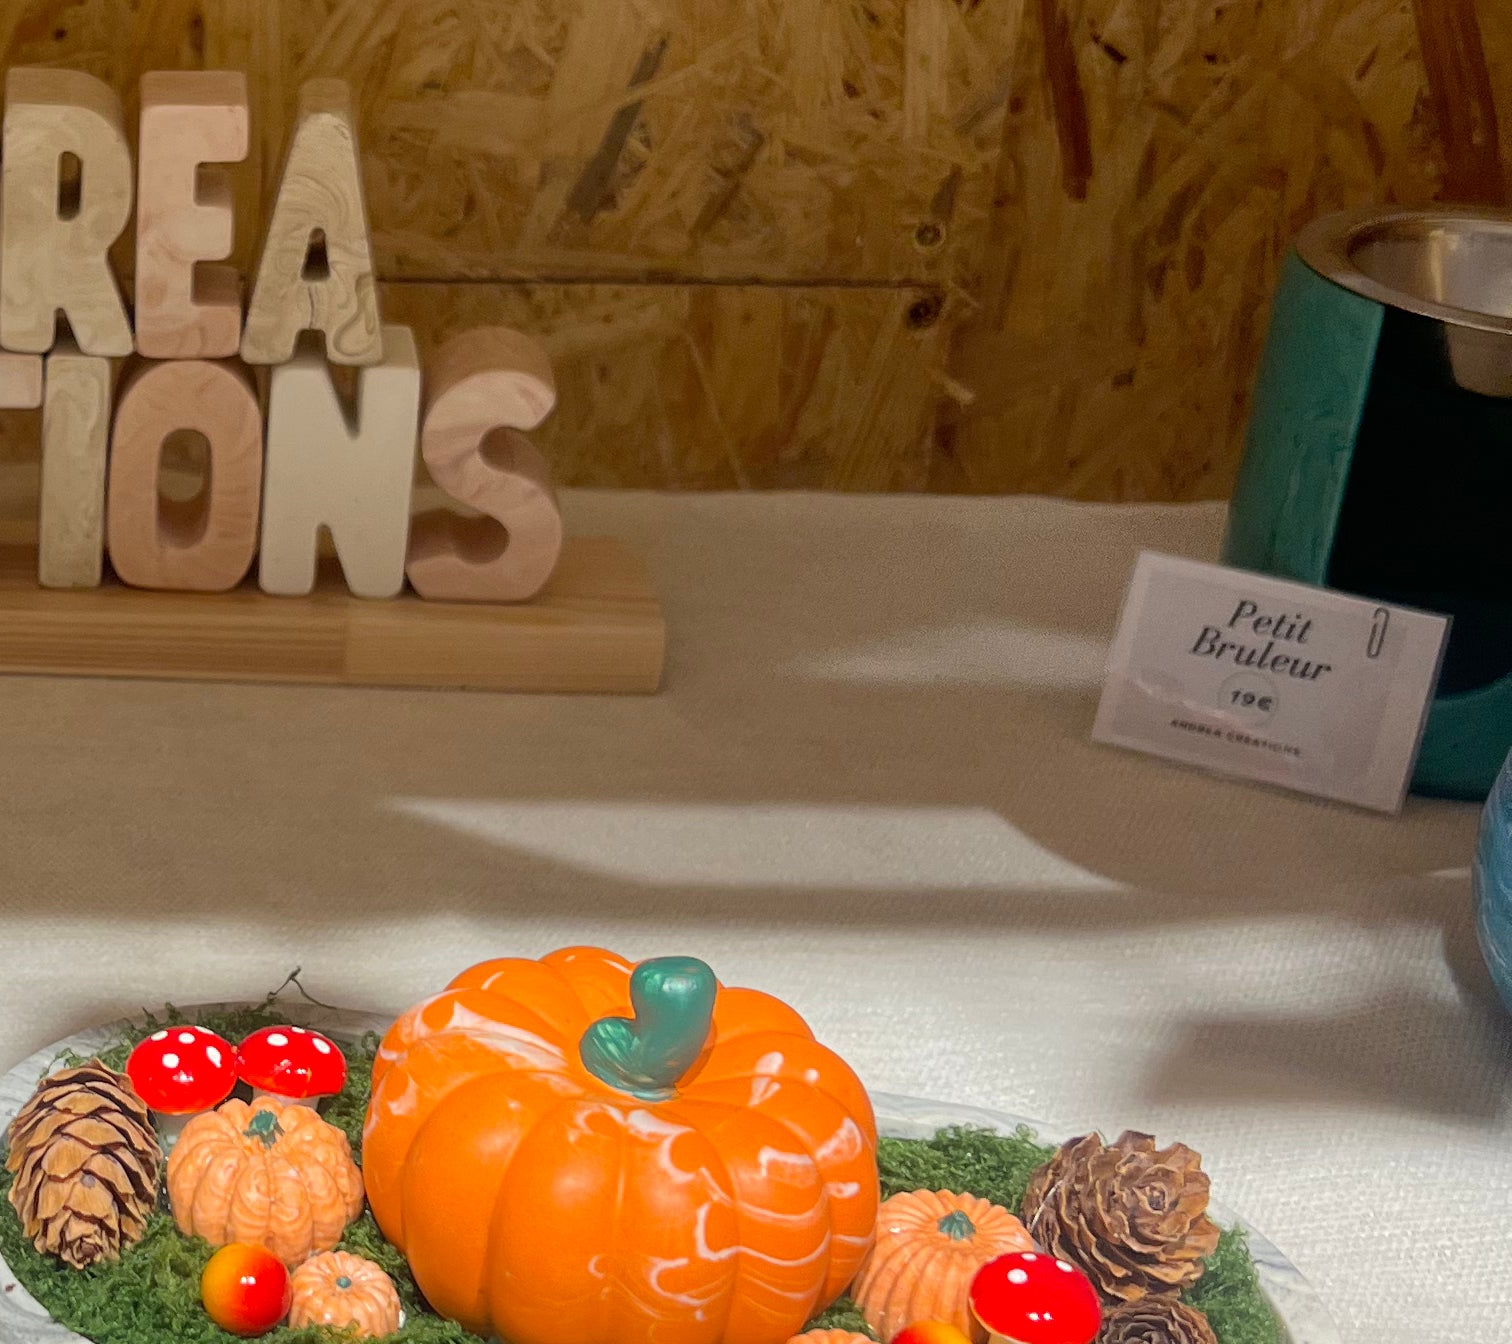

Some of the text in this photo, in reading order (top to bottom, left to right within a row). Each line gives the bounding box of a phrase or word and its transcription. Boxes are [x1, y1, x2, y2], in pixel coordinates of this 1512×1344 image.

[1227, 599, 1313, 644] Petit
[1190, 626, 1332, 681] Bruleur
[1231, 688, 1273, 712] 19€
